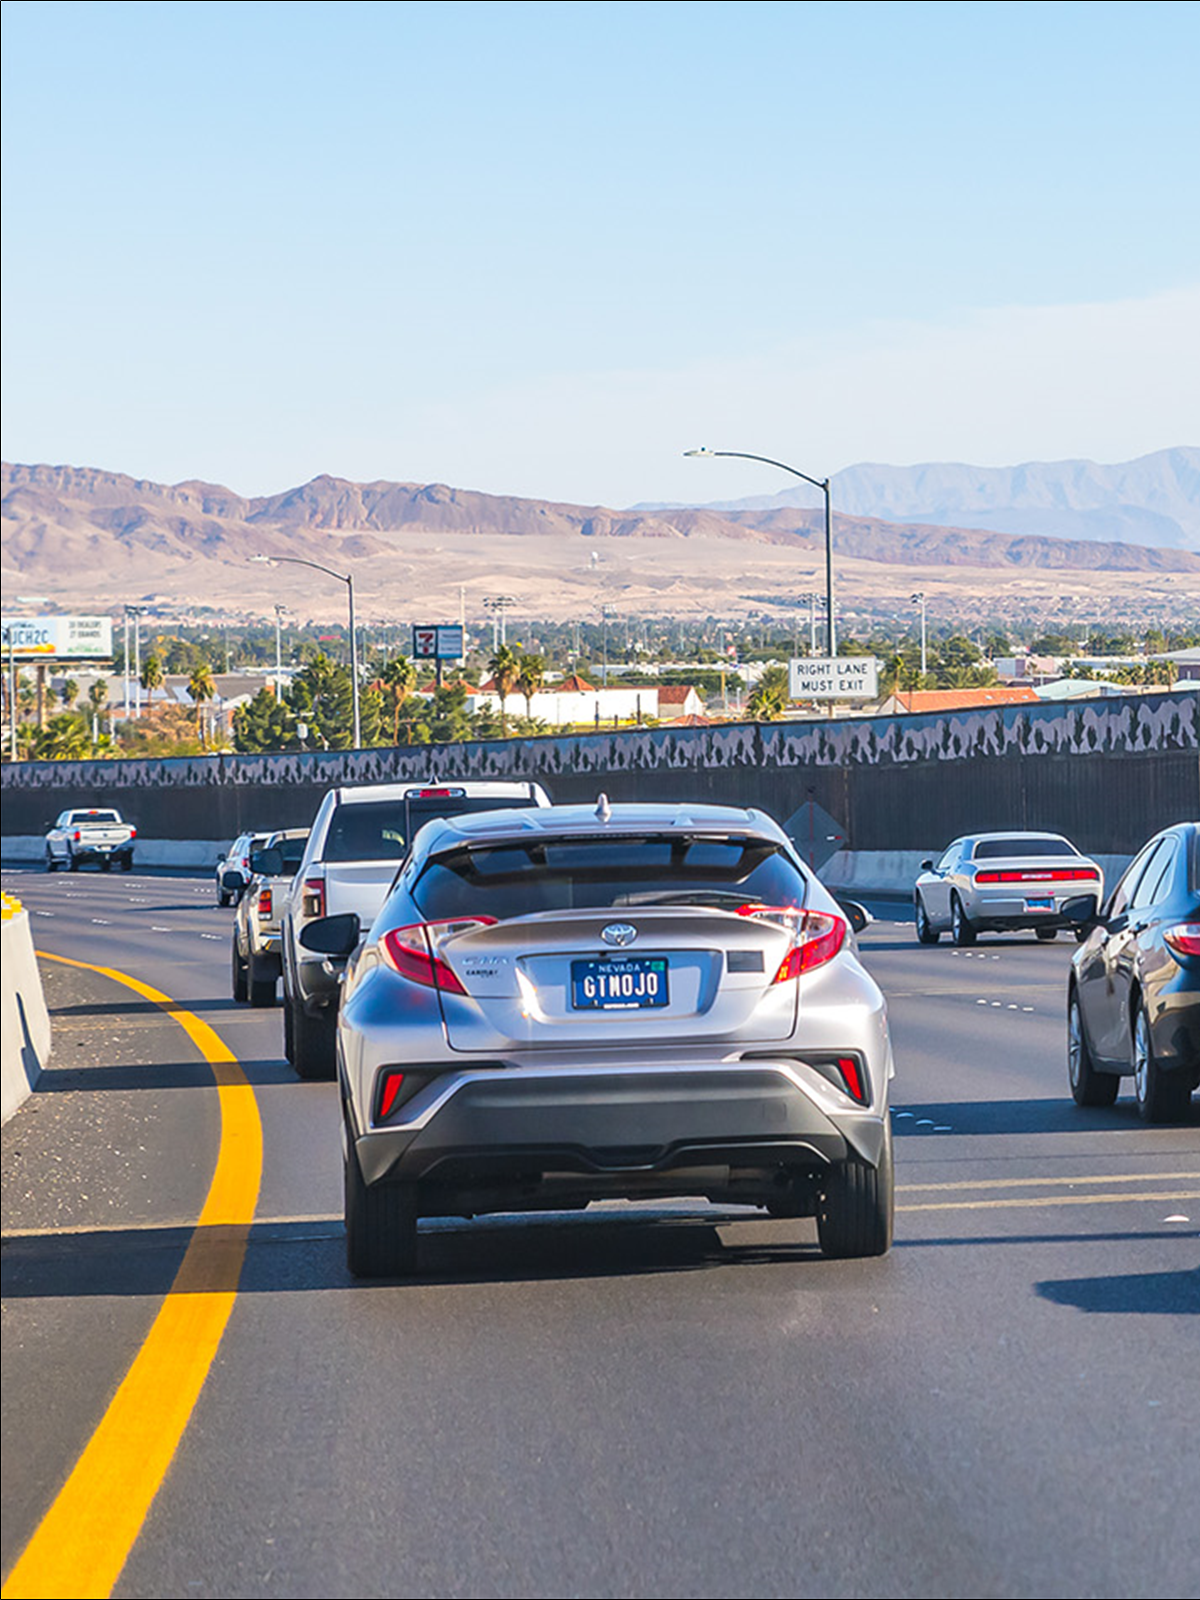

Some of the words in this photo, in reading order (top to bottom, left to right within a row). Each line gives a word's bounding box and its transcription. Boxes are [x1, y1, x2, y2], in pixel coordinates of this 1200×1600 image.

[797, 664, 831, 676] RIGHT
[837, 663, 868, 675] LANE
[801, 680, 833, 692] MUST
[839, 680, 864, 691] EXIT
[598, 963, 640, 973] NEVADA
[583, 972, 659, 998] GTMOJO
